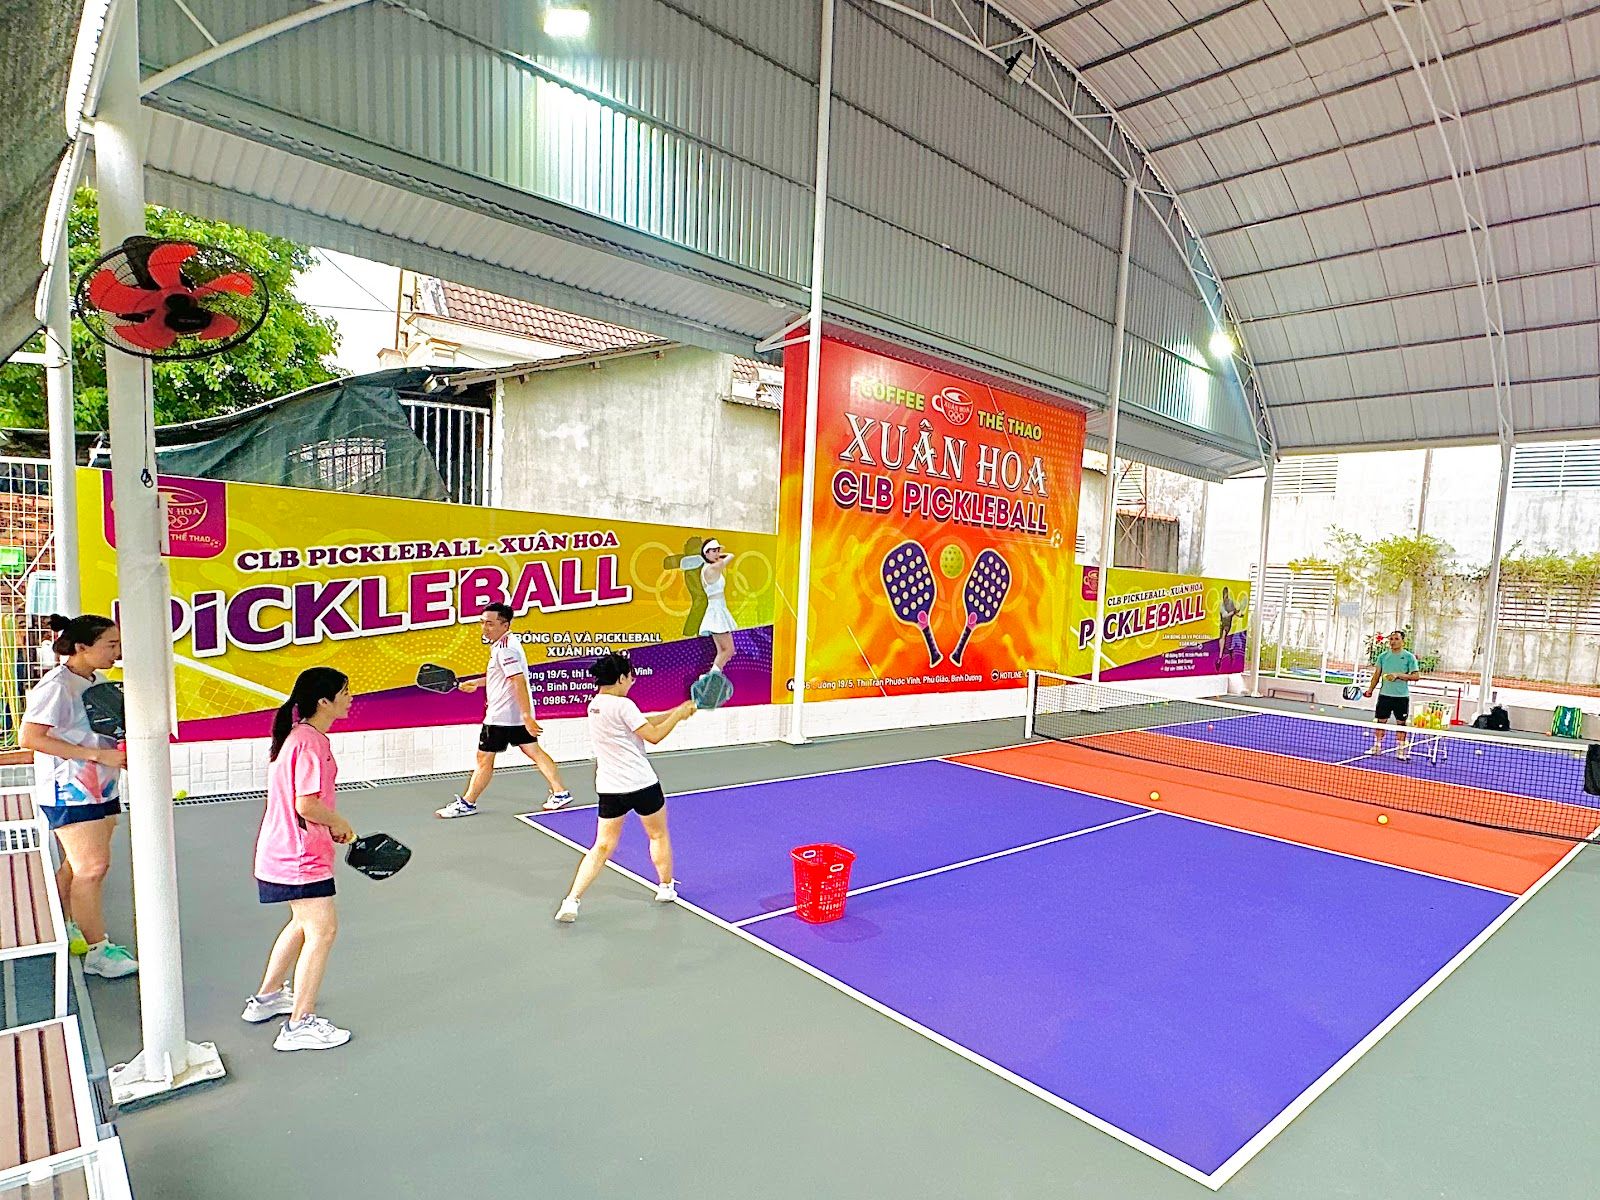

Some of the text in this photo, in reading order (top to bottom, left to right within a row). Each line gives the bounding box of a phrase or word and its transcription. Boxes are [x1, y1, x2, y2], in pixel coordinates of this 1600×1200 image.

[859, 380, 925, 411] COFFEE
[978, 410, 1043, 441] THẾ THAO
[840, 412, 1049, 497] XUÂN HOA
[176, 507, 202, 516] HOA
[832, 468, 1049, 534] CLB PICKLEBALL
[189, 534, 211, 543] THAO
[236, 549, 301, 571] CLB
[306, 539, 483, 567] PICKLEBALL
[499, 531, 569, 555] XUÂN
[572, 531, 619, 549] HOA
[1107, 598, 1122, 607] CLB
[1123, 588, 1166, 604] PICKLEBALL
[1190, 581, 1203, 592] HOA
[1078, 594, 1206, 648] PCKLEBALL
[574, 631, 592, 643] VÀ
[594, 633, 663, 643] PICKLEBALL
[585, 646, 612, 657] HOA
[546, 669, 570, 680] 19/5,
[572, 669, 585, 680] thị
[838, 679, 855, 689] 19/5,
